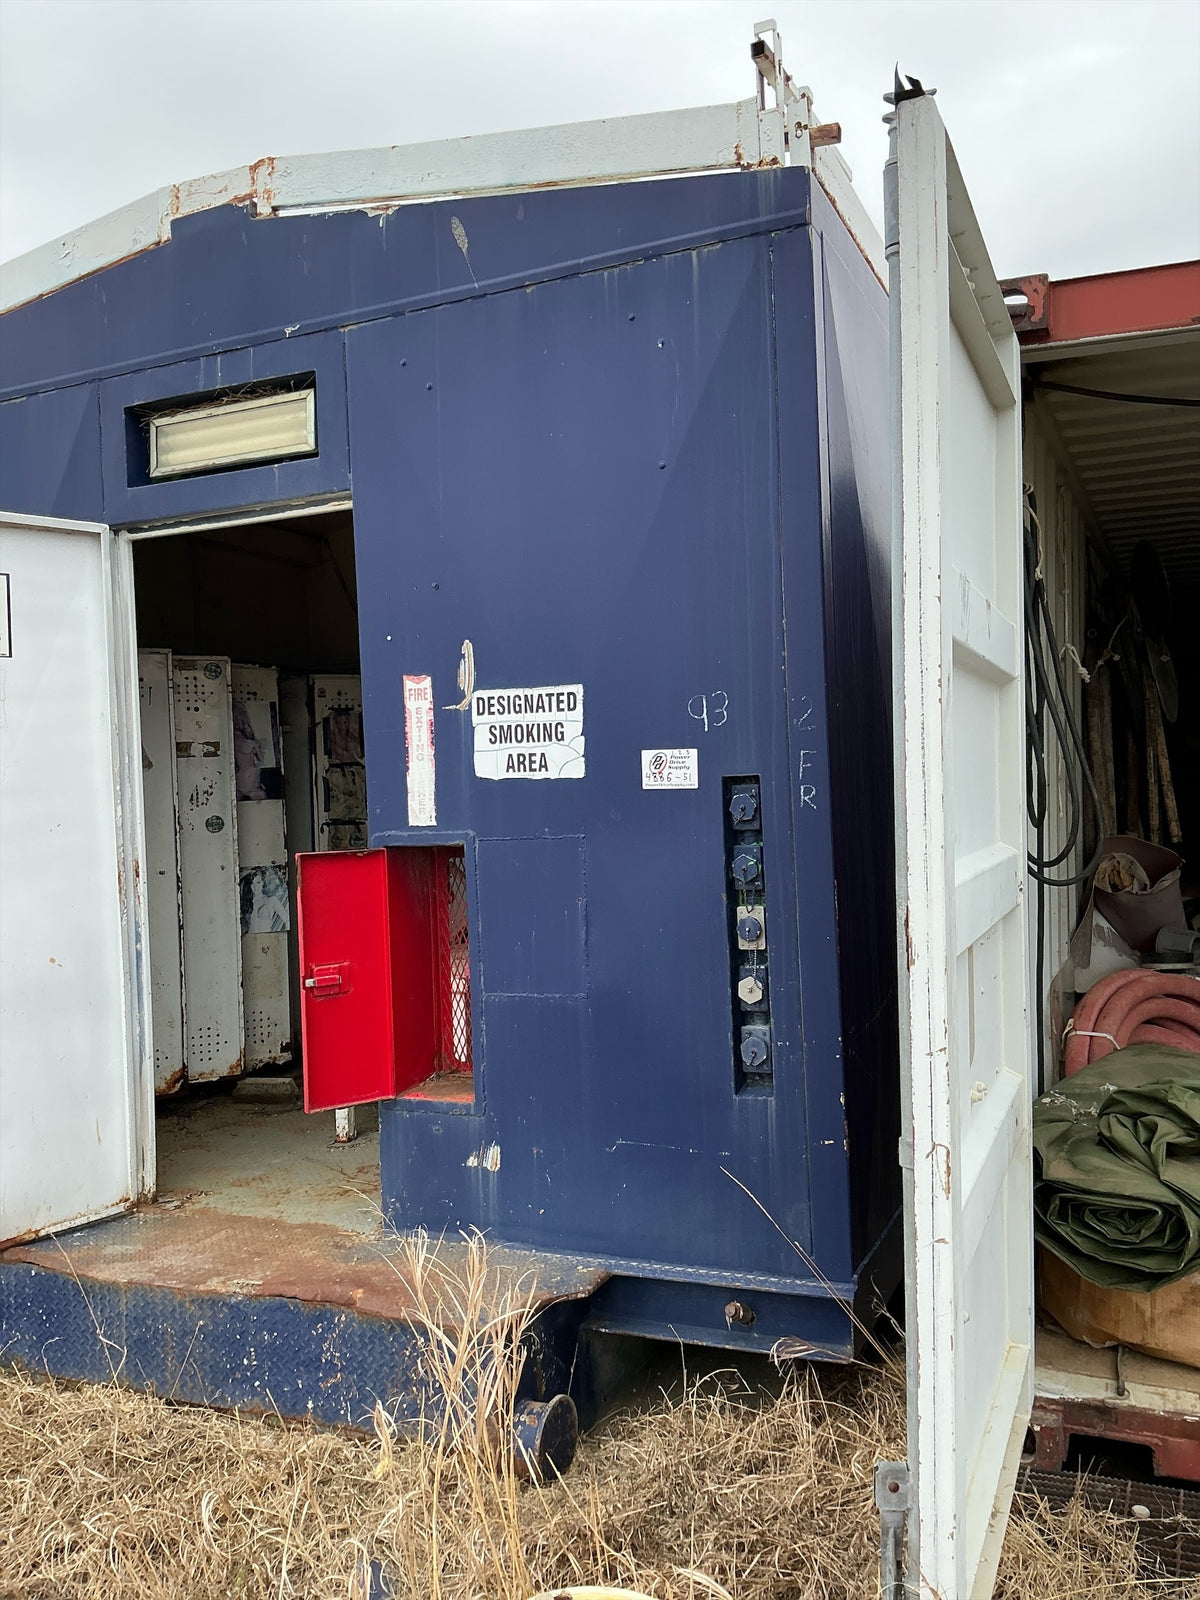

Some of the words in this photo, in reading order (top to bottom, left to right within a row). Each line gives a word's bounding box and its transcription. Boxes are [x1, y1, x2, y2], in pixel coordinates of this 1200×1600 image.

[408, 687, 429, 702] FIRE
[476, 691, 577, 717] DESIGNATED
[687, 691, 729, 732] 93
[488, 722, 565, 745] SMOKING
[505, 751, 549, 773] AREA
